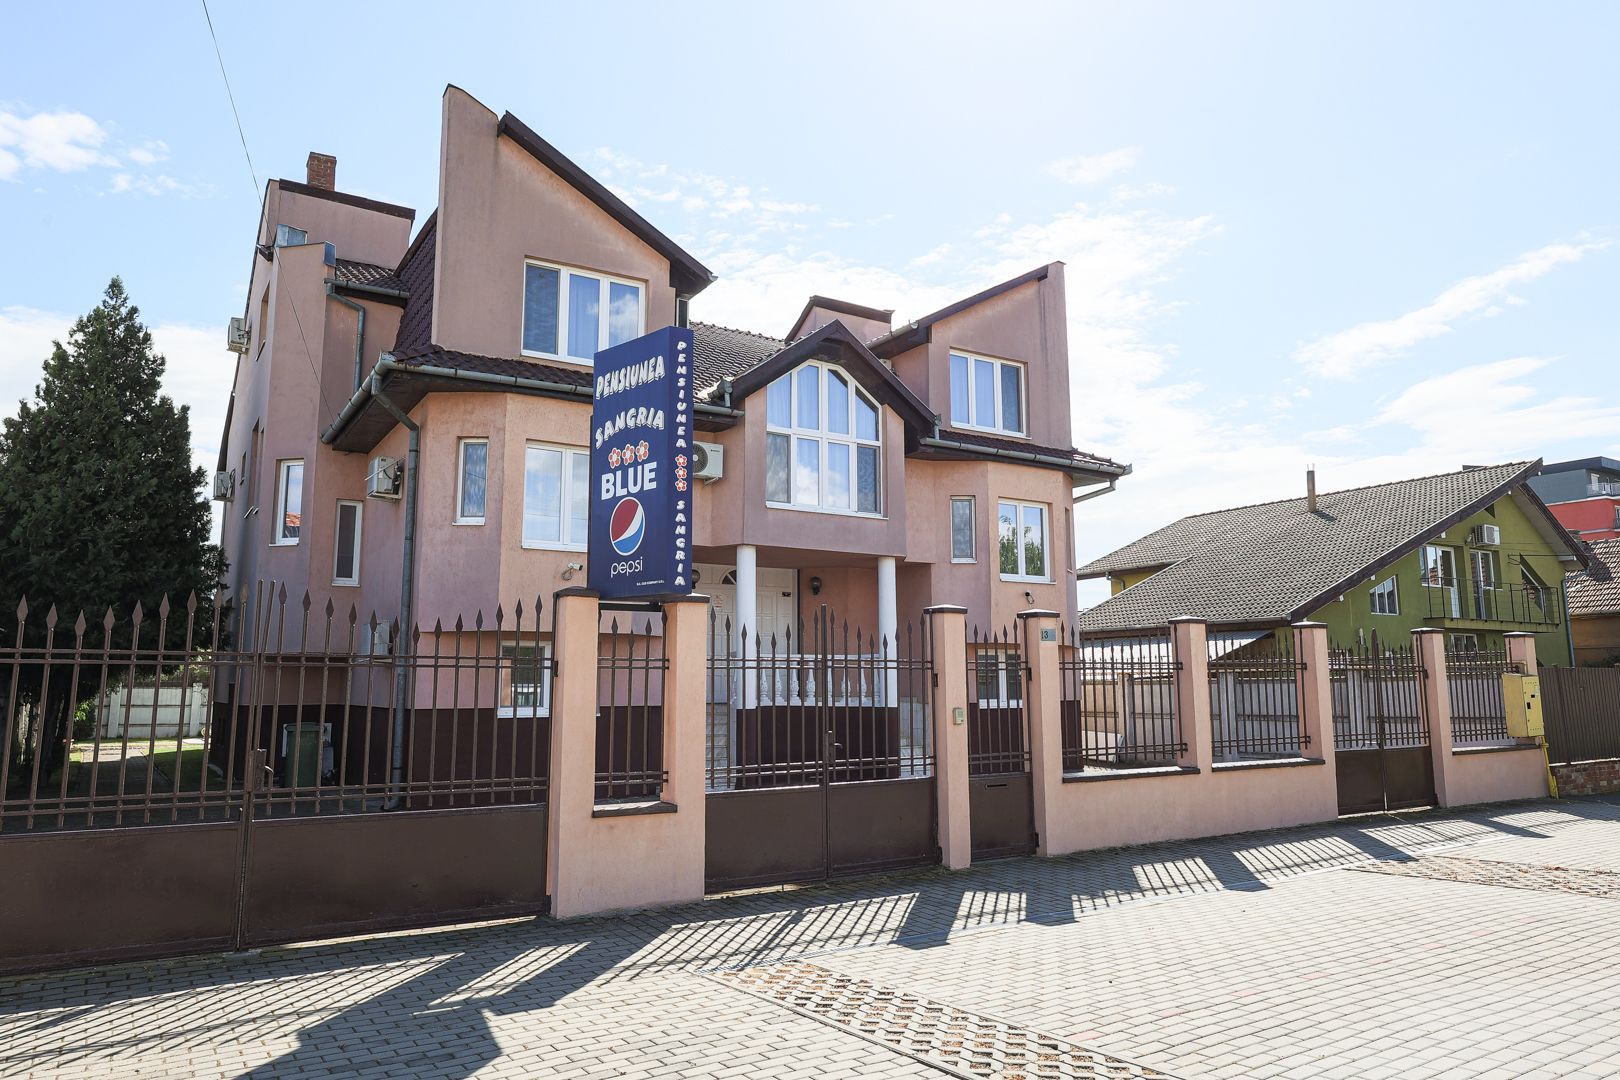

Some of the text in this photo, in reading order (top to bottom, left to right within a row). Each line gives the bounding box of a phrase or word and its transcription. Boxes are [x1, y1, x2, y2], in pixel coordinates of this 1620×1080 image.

[595, 355, 665, 400] PENSIUNEA
[676, 341, 687, 448] PENSIUNEA
[595, 406, 664, 450] SANGRIA
[601, 461, 657, 500] BLUE
[674, 500, 686, 586] SANGRIA
[610, 556, 643, 578] pepsi
[1041, 630, 1049, 640] 13
